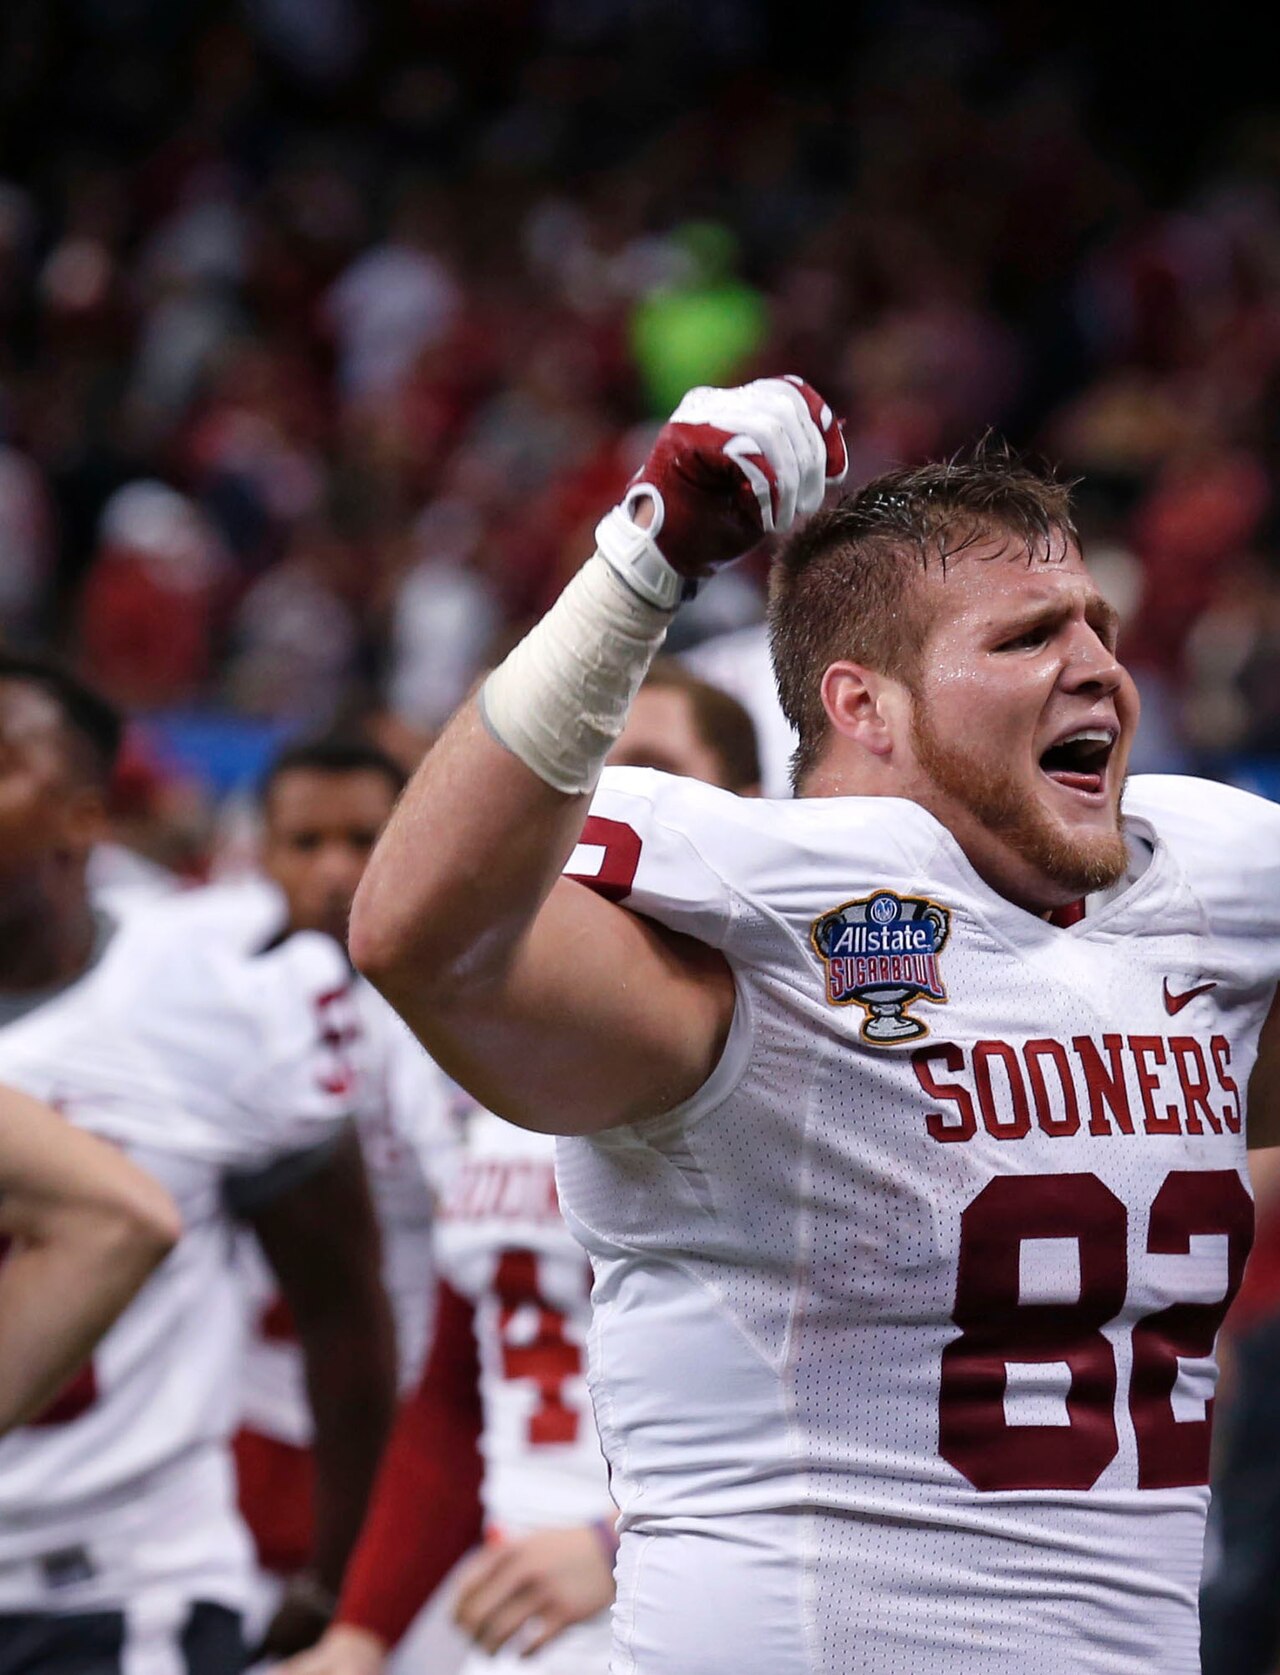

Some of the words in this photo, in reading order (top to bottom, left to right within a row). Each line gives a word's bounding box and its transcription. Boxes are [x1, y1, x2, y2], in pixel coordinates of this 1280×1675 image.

[833, 925, 926, 953] Allstate
[912, 1034, 1241, 1143] SOONERS
[938, 1169, 1255, 1492] 82
